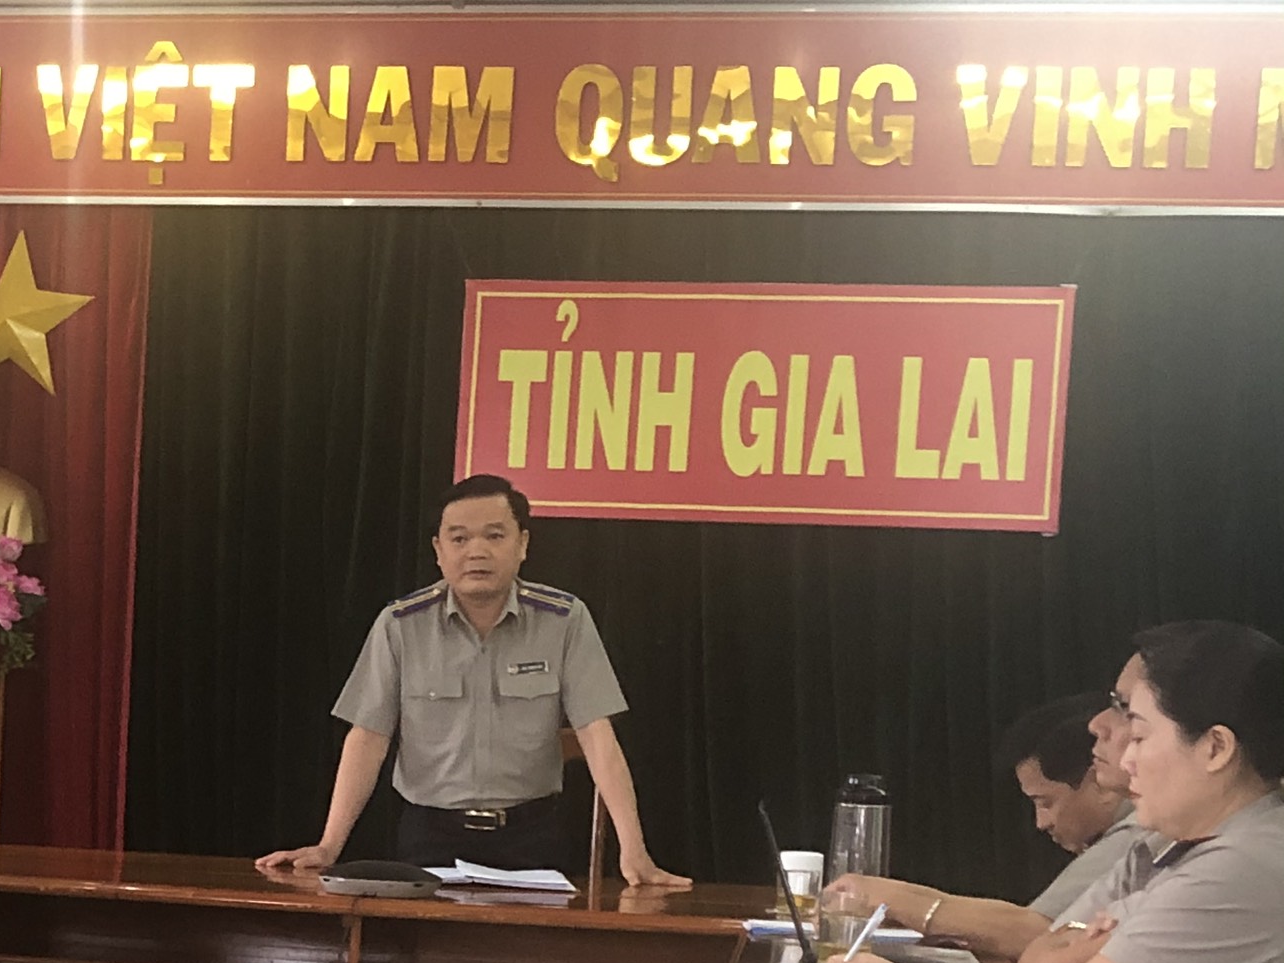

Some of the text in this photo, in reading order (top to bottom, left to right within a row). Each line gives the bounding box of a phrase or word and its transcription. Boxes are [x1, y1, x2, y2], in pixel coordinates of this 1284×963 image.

[37, 41, 255, 184] VIỆT
[286, 64, 515, 163] NAM
[555, 64, 917, 181] QUANG
[957, 64, 1216, 169] VINH
[498, 300, 1034, 481] TỈNH GIA LAI
